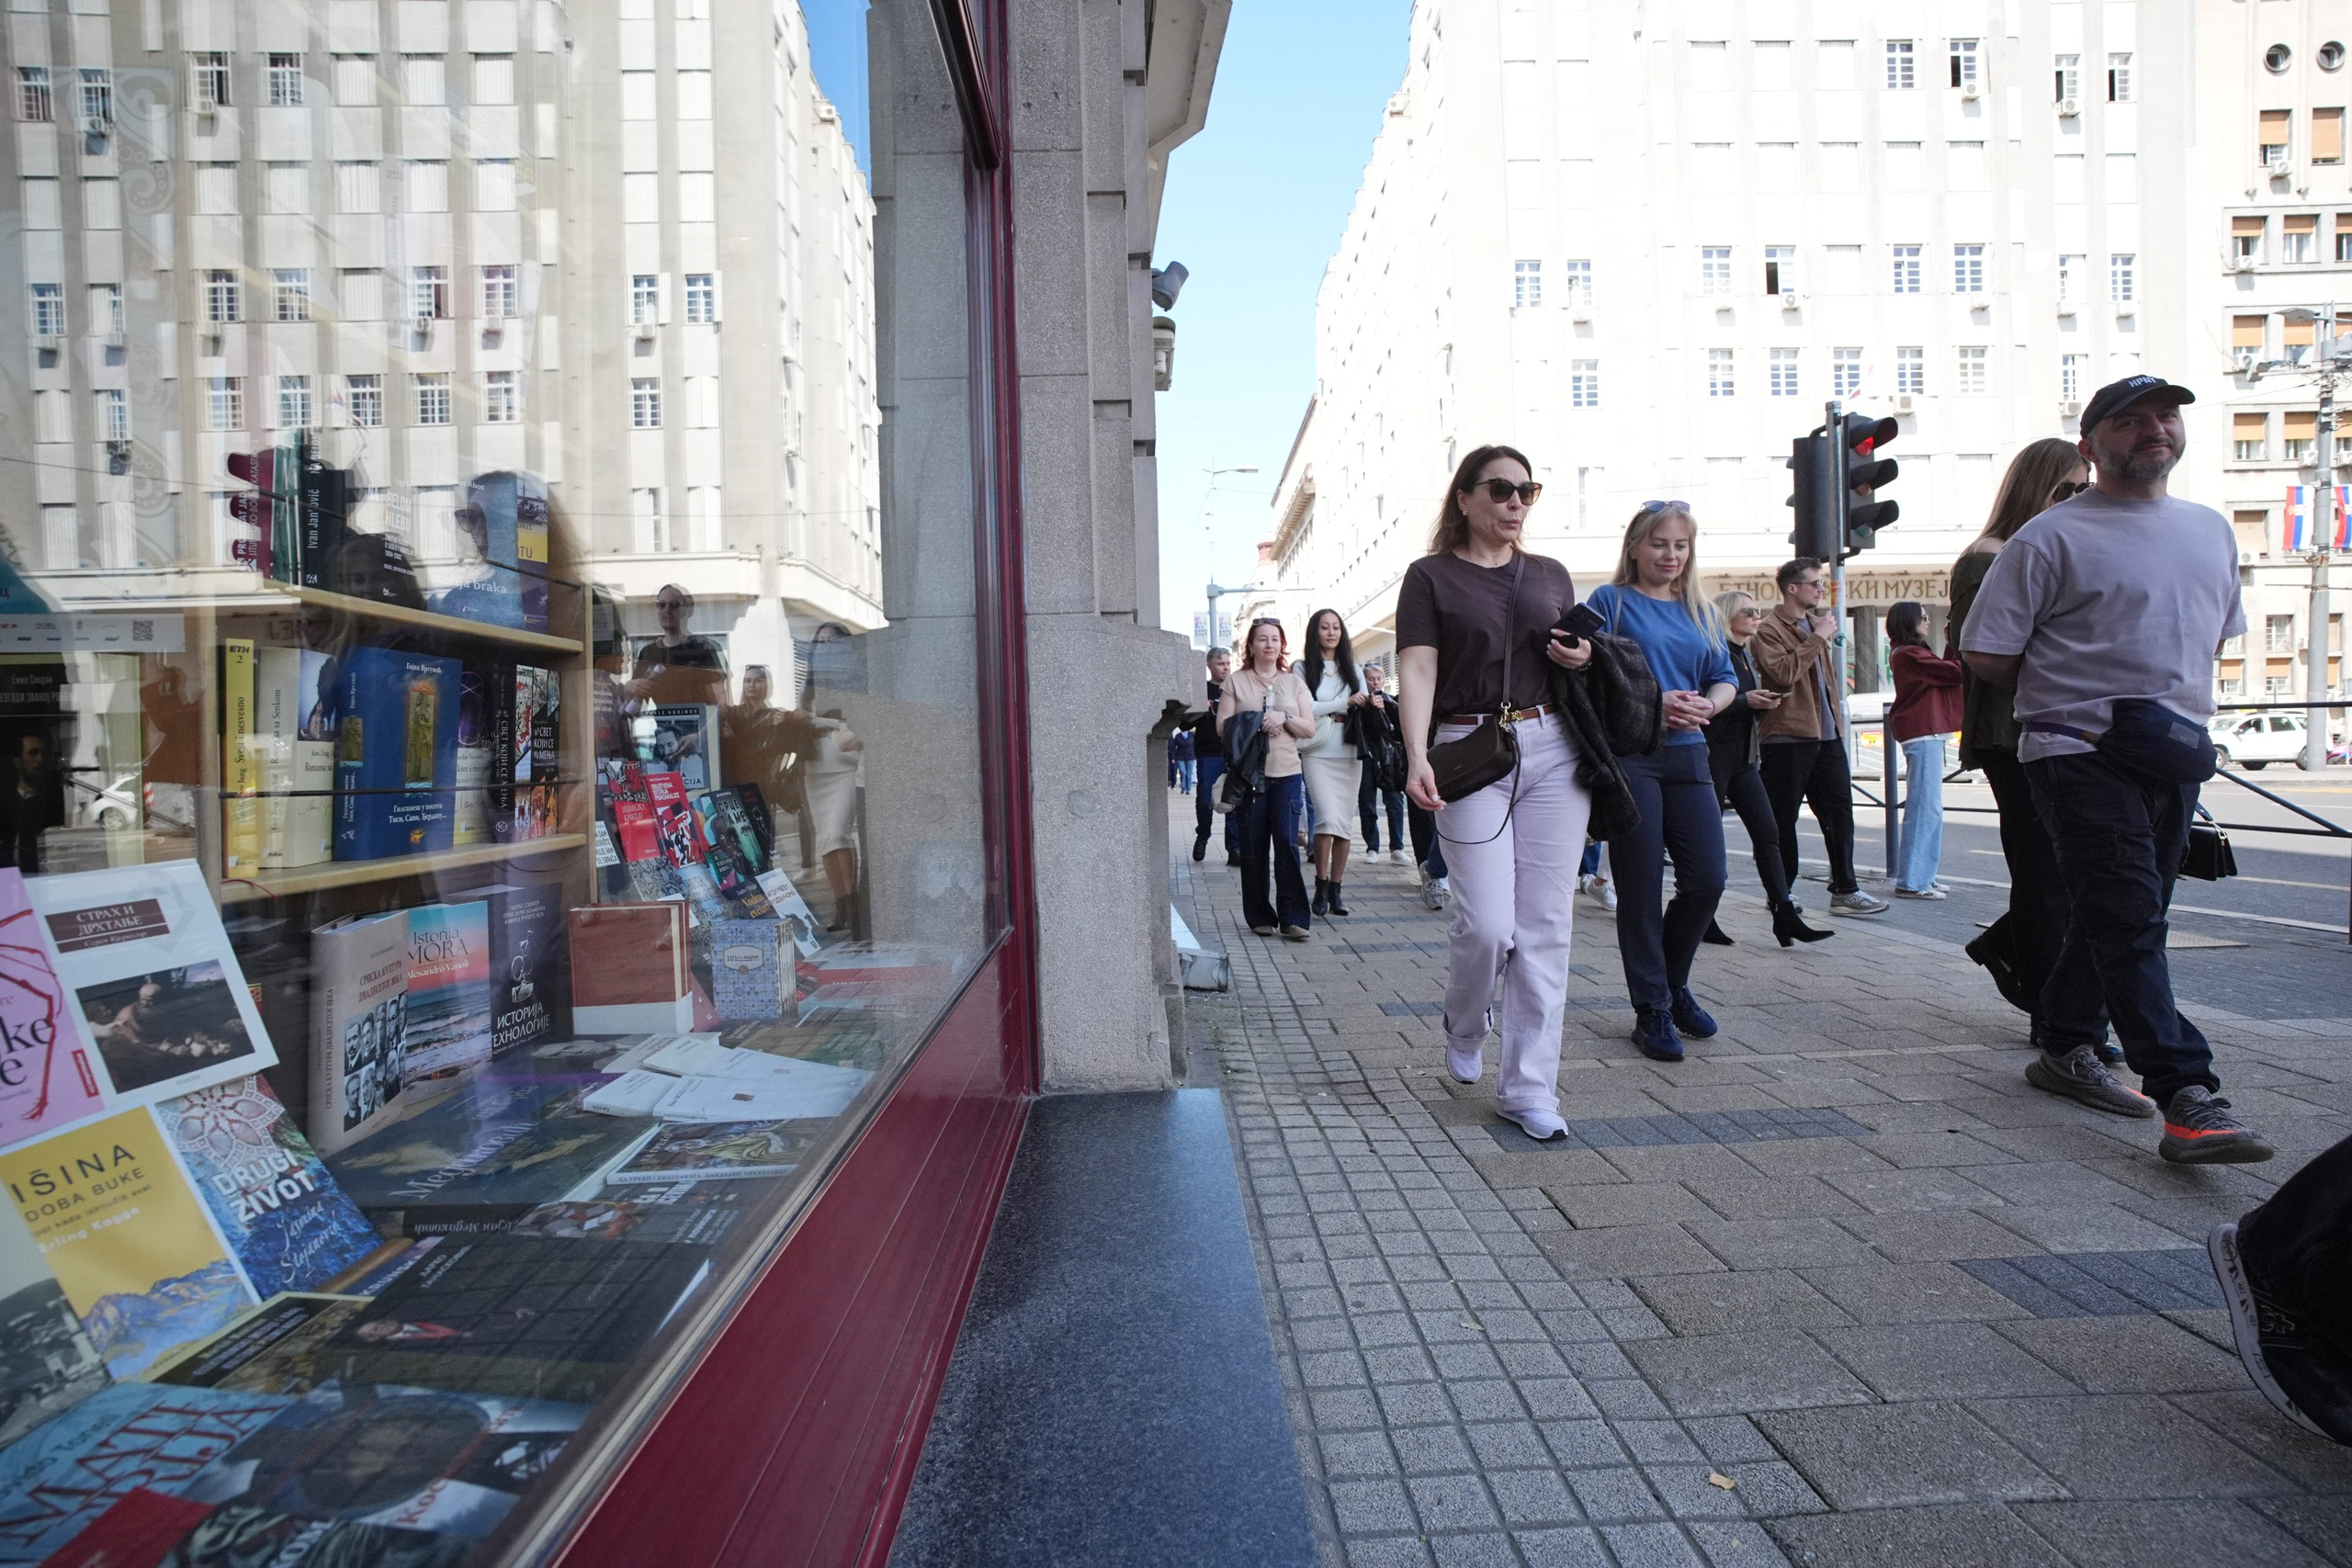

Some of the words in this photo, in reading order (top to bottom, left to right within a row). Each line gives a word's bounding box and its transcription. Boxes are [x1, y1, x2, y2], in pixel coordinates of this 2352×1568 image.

[2128, 376, 2157, 388] HPNY
[468, 481, 485, 491] Abot
[308, 489, 320, 528] Janović
[386, 491, 412, 513] BELOM
[385, 510, 411, 532] HLEBU
[307, 530, 320, 548] Ivan
[473, 578, 508, 594] braka
[1884, 579, 1949, 598] МУЗЕЈ
[236, 655, 243, 664] 2
[406, 662, 420, 671] Гојко
[272, 689, 281, 719] Senkom
[274, 720, 280, 728] sa
[540, 727, 552, 736] СВЕТ
[533, 739, 546, 750] КОЈИ
[547, 739, 554, 747] СЕ
[539, 749, 555, 761] МЕЊА
[237, 767, 247, 783] Jung
[305, 762, 326, 772] Romansa
[501, 768, 508, 778] СЕ
[394, 805, 421, 813] Гилгамеш
[718, 799, 739, 812] СРЦЕ
[405, 814, 420, 822] Сави,
[720, 811, 747, 827] ТАМЕ
[76, 907, 120, 924] СТРАХ
[124, 905, 135, 915] И
[78, 916, 142, 936] ДРХТАЊЕ
[413, 925, 460, 946] Istorija
[408, 938, 469, 965] MORA
[359, 966, 382, 987] СРПСКА
[382, 959, 402, 979] КУЛТУРА
[407, 963, 445, 980] Alesandro
[446, 959, 469, 972] Vanoli
[358, 978, 390, 1004] ДВАДЕСЕТОГ
[390, 974, 403, 992] ВЕКА
[497, 1002, 544, 1030] ИСТОРИЈА
[326, 1008, 334, 1049] ДВАДЕСЕТОГ
[326, 1050, 334, 1081] КУЛТУРА
[325, 1082, 334, 1109] СРПСКА
[10, 1143, 136, 1206] IŠINA
[210, 1148, 300, 1197] DRUGI
[657, 1172, 701, 1181] БИОГРАФИЈА
[704, 1170, 742, 1179] ПАНДЕЛИС
[24, 1193, 86, 1223] DOBA
[90, 1167, 146, 1194] BUKE
[226, 1169, 317, 1224] ŽIVOT
[414, 1222, 479, 1237] Медаковић
[37, 1226, 89, 1255] Erling
